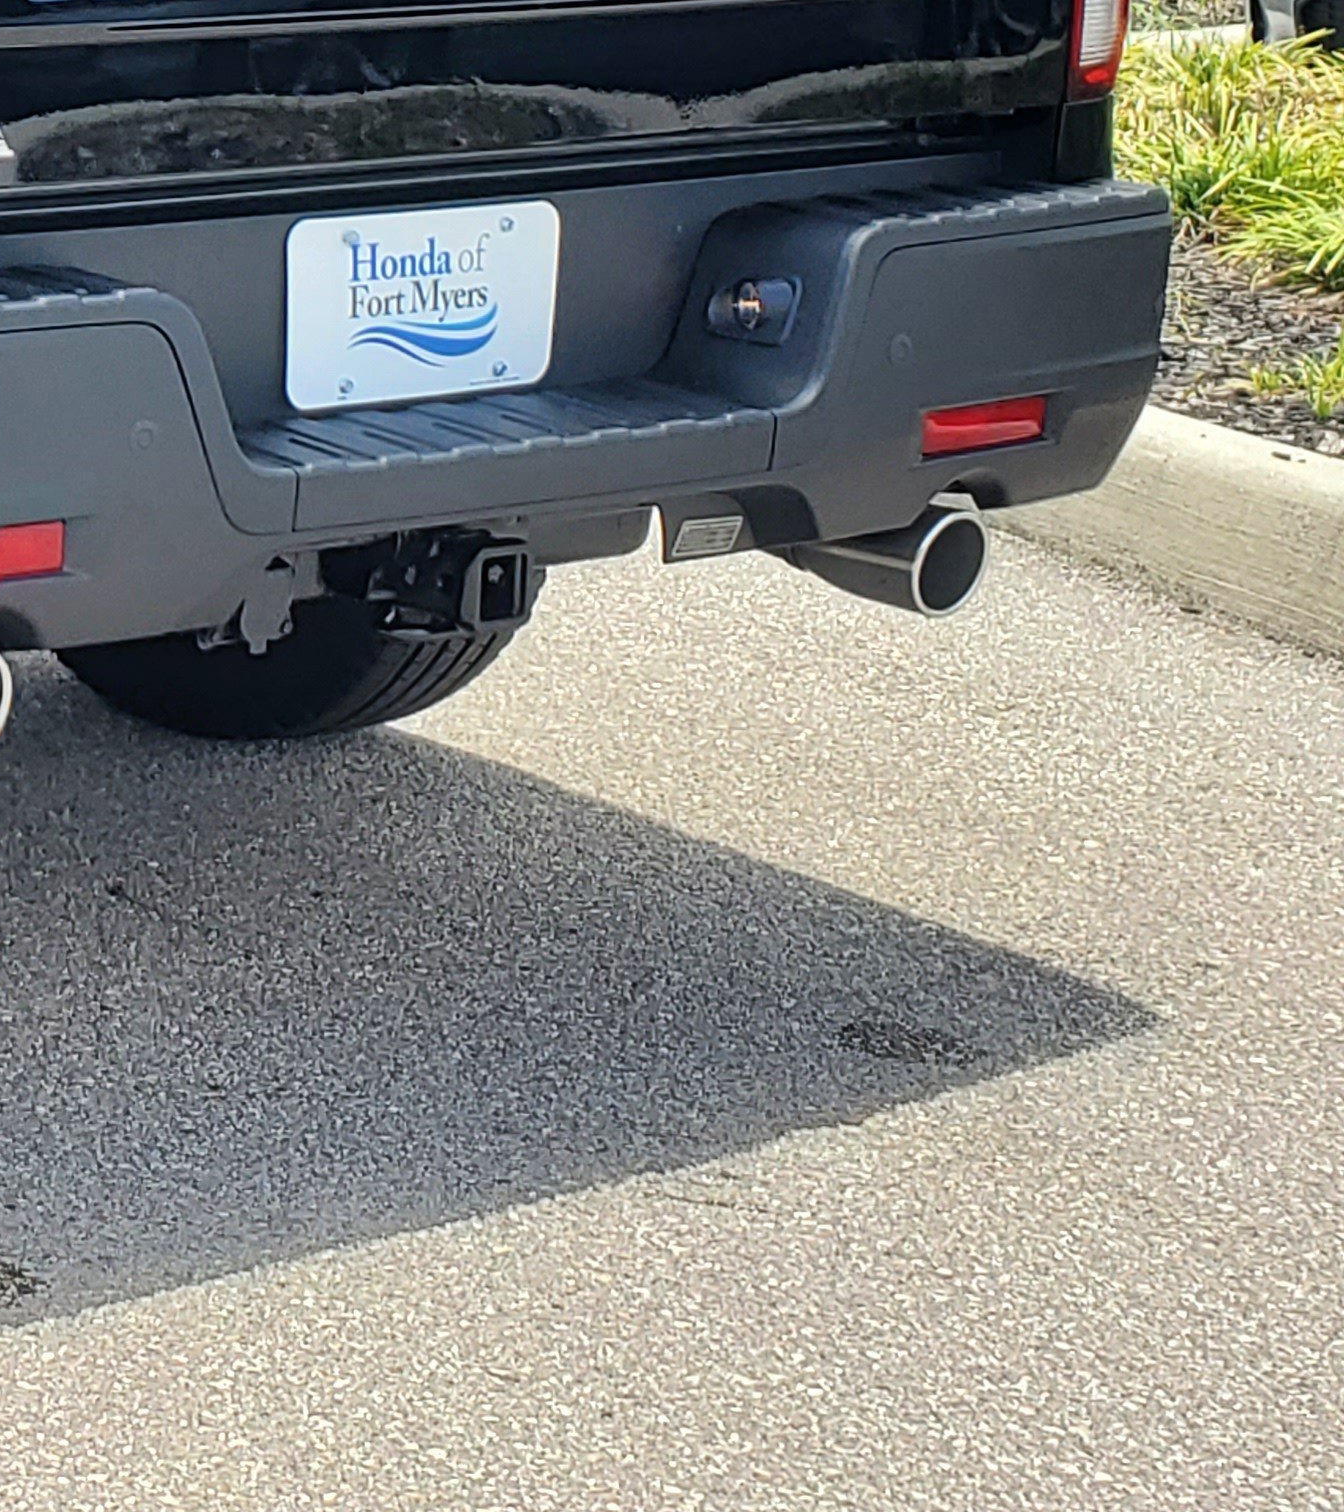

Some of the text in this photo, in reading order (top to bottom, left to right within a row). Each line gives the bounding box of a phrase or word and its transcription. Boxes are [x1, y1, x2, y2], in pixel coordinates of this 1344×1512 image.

[348, 233, 491, 283] Honda of
[348, 278, 489, 323] Fort Myers
